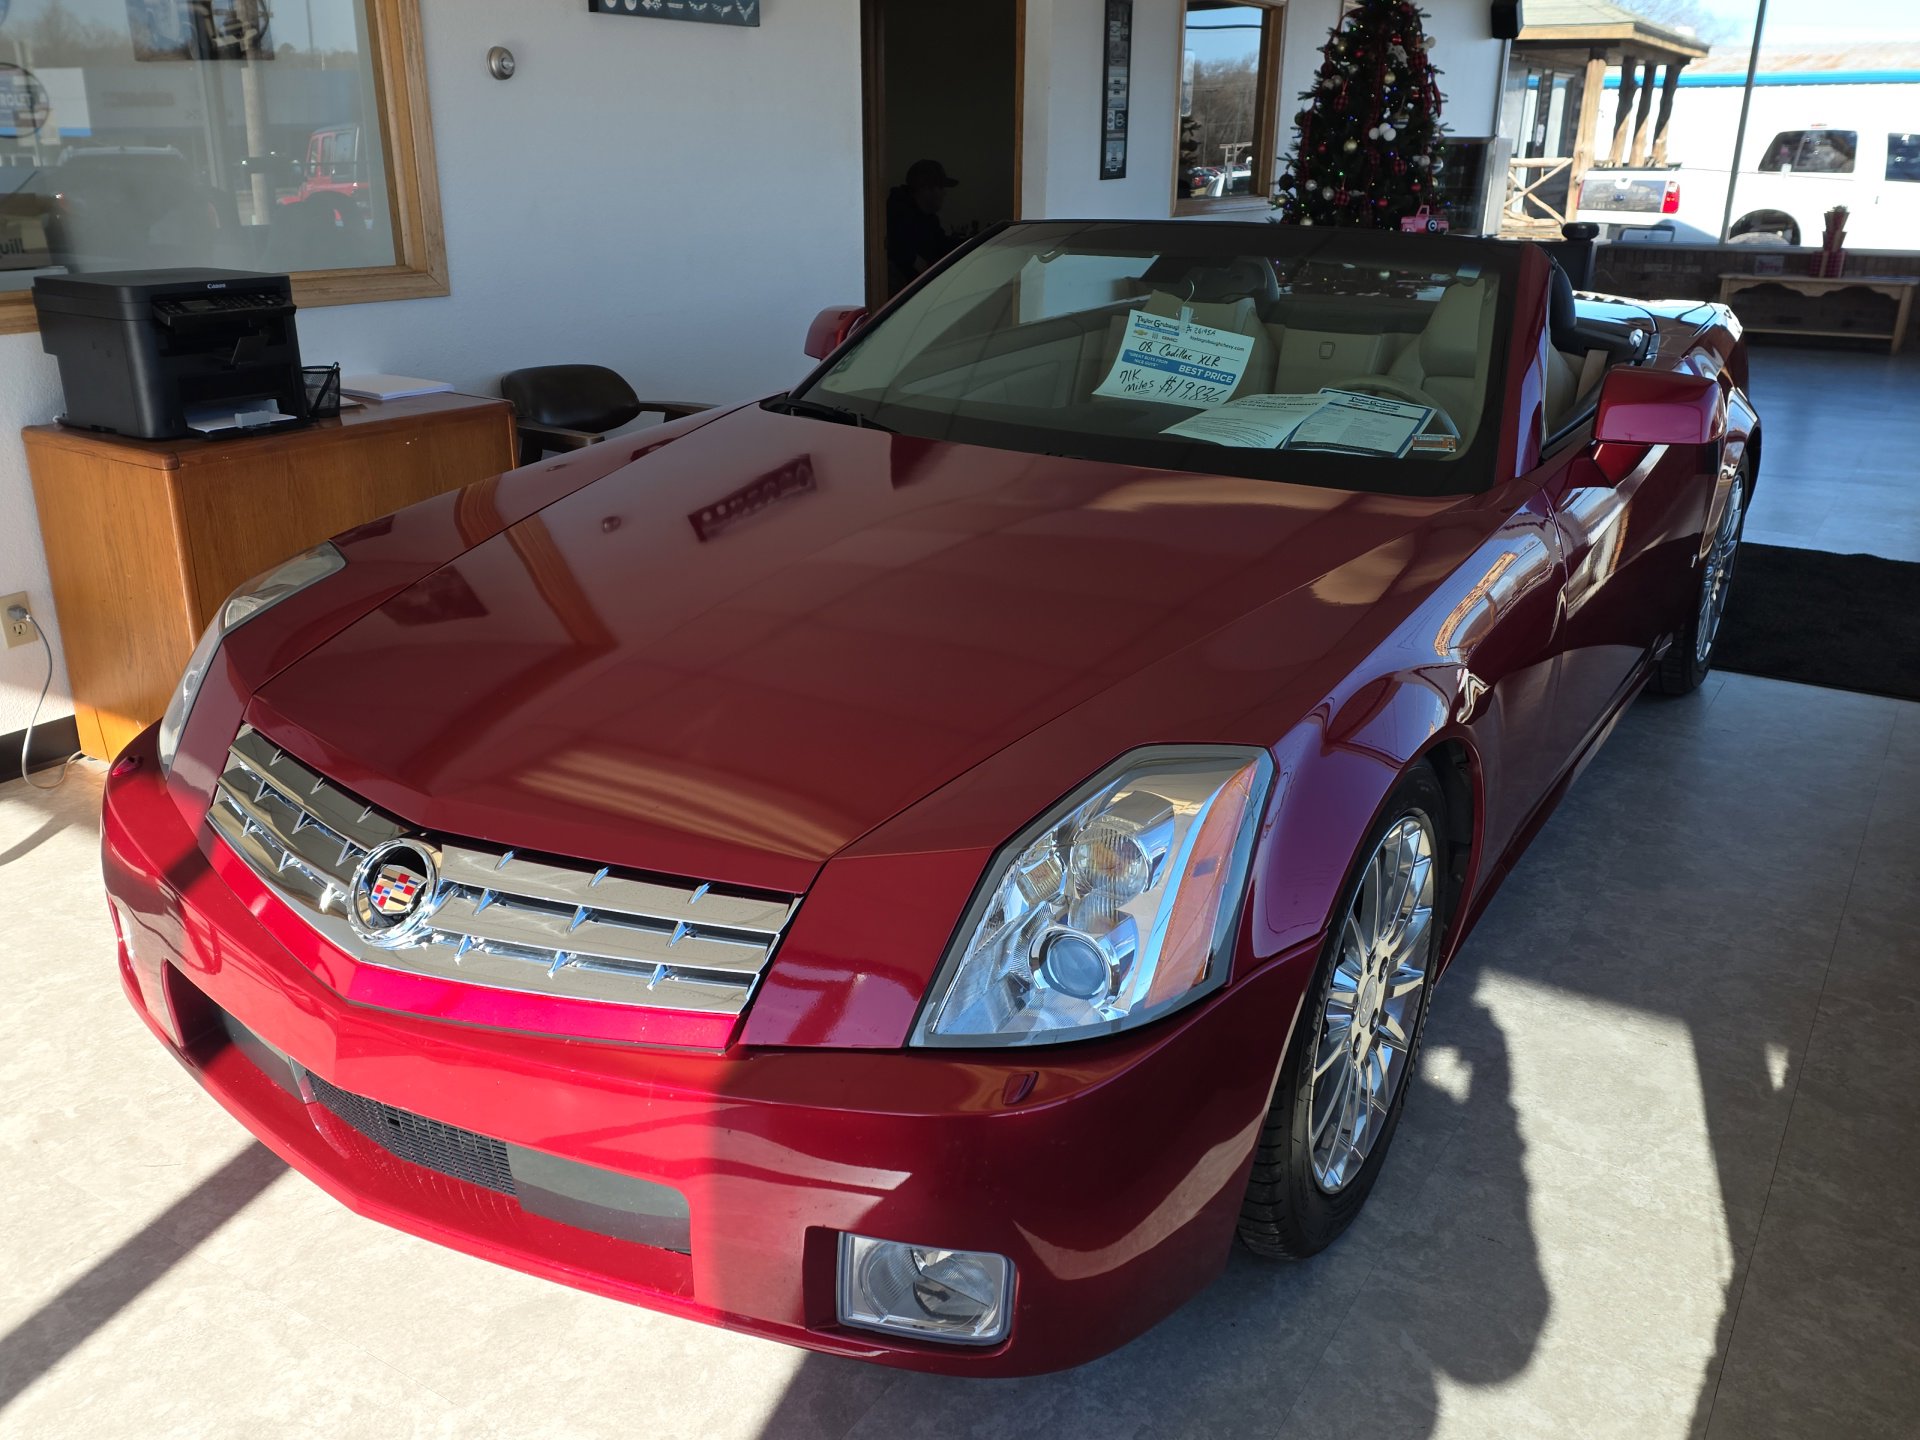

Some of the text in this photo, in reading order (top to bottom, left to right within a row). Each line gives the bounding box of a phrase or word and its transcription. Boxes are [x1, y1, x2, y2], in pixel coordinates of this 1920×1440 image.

[0, 236, 24, 253] uill
[1138, 341, 1221, 367] 08 Cadillac XLR
[1178, 365, 1234, 384] BEST PRICE
[1156, 375, 1227, 403] $19,836
